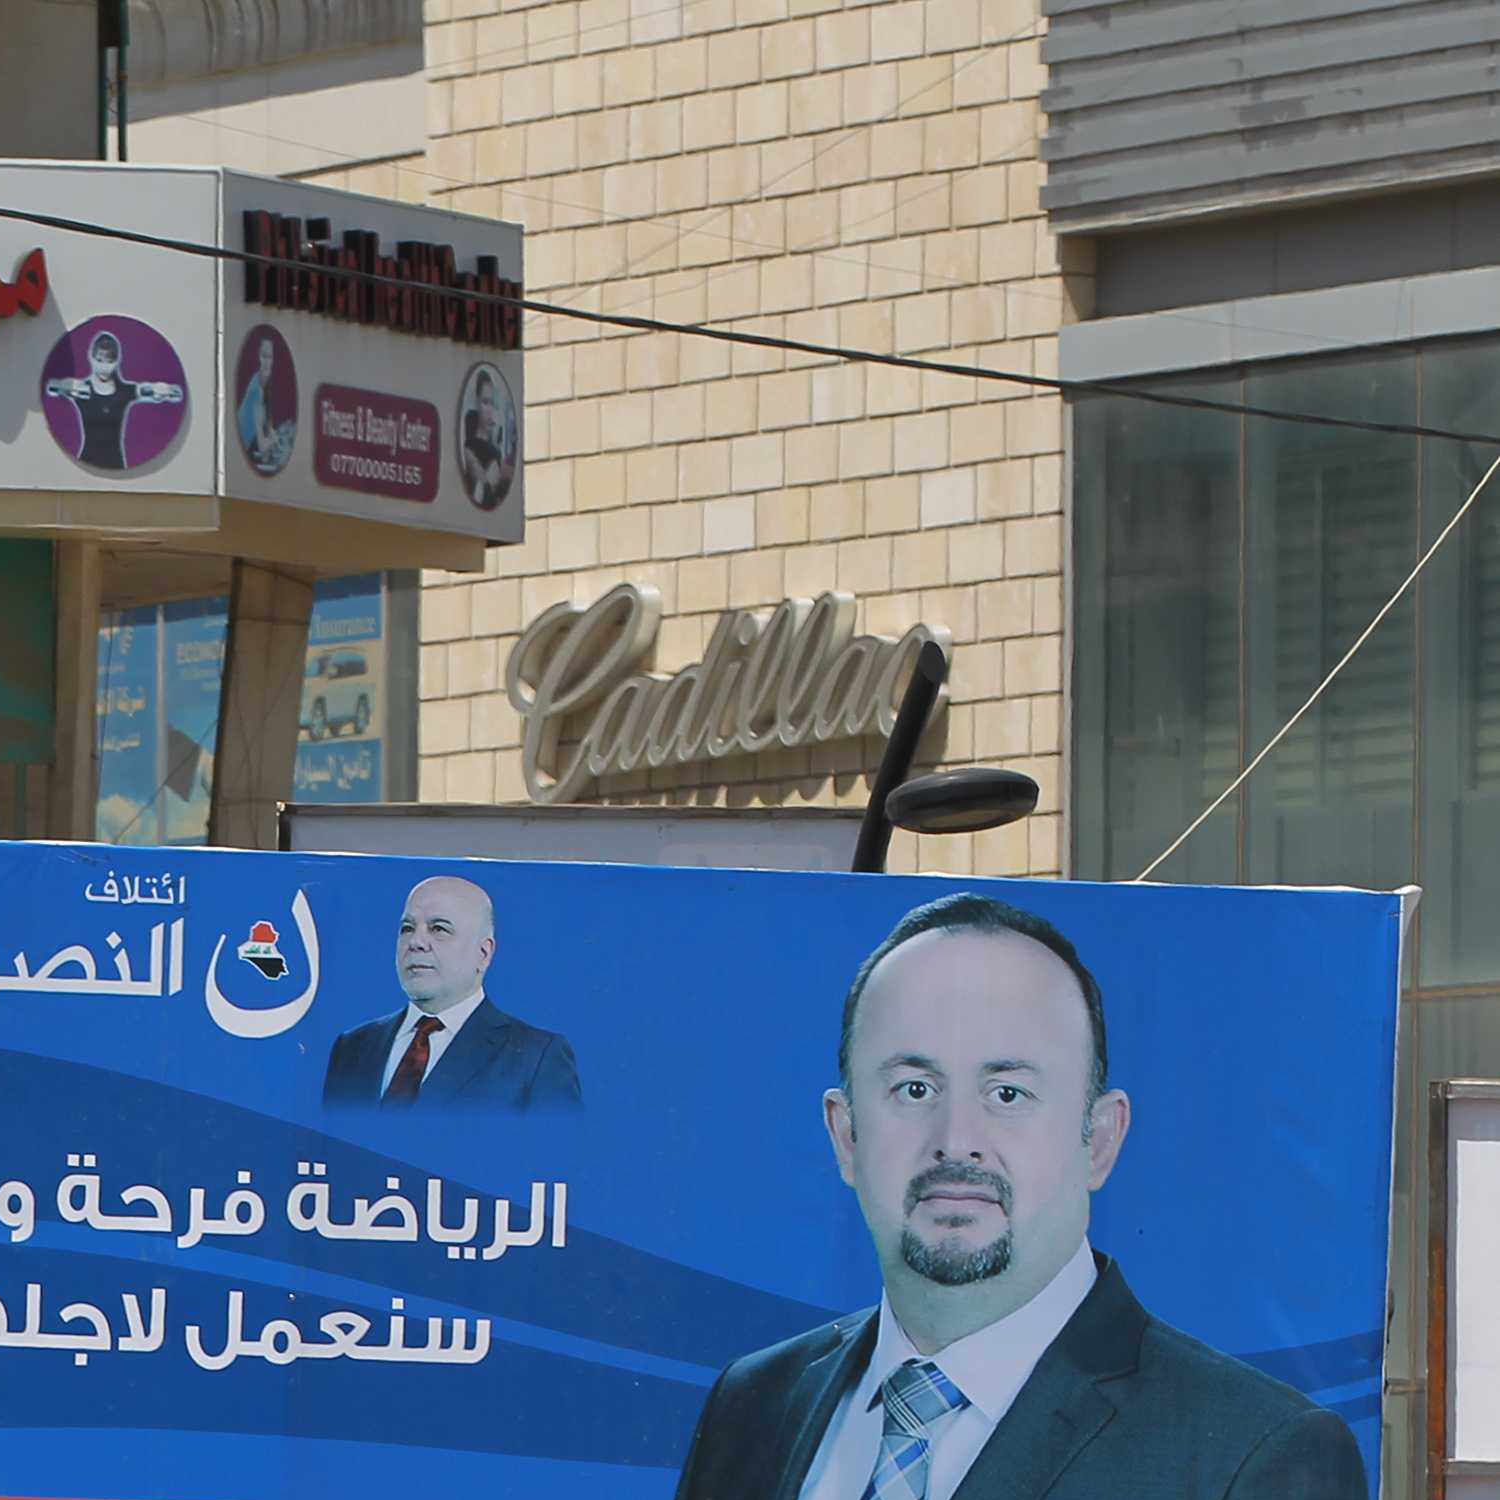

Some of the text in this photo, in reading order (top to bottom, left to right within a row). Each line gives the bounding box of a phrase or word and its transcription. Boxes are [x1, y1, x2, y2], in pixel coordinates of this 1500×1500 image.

[330, 453, 422, 486] 07700005165
[506, 582, 953, 804] Cadillac
[84, 873, 187, 906] ائتلاف
[55, 1152, 266, 1249] فرحة
[285, 1160, 569, 1261] الرياضة
[184, 1288, 492, 1371] سنعمل
